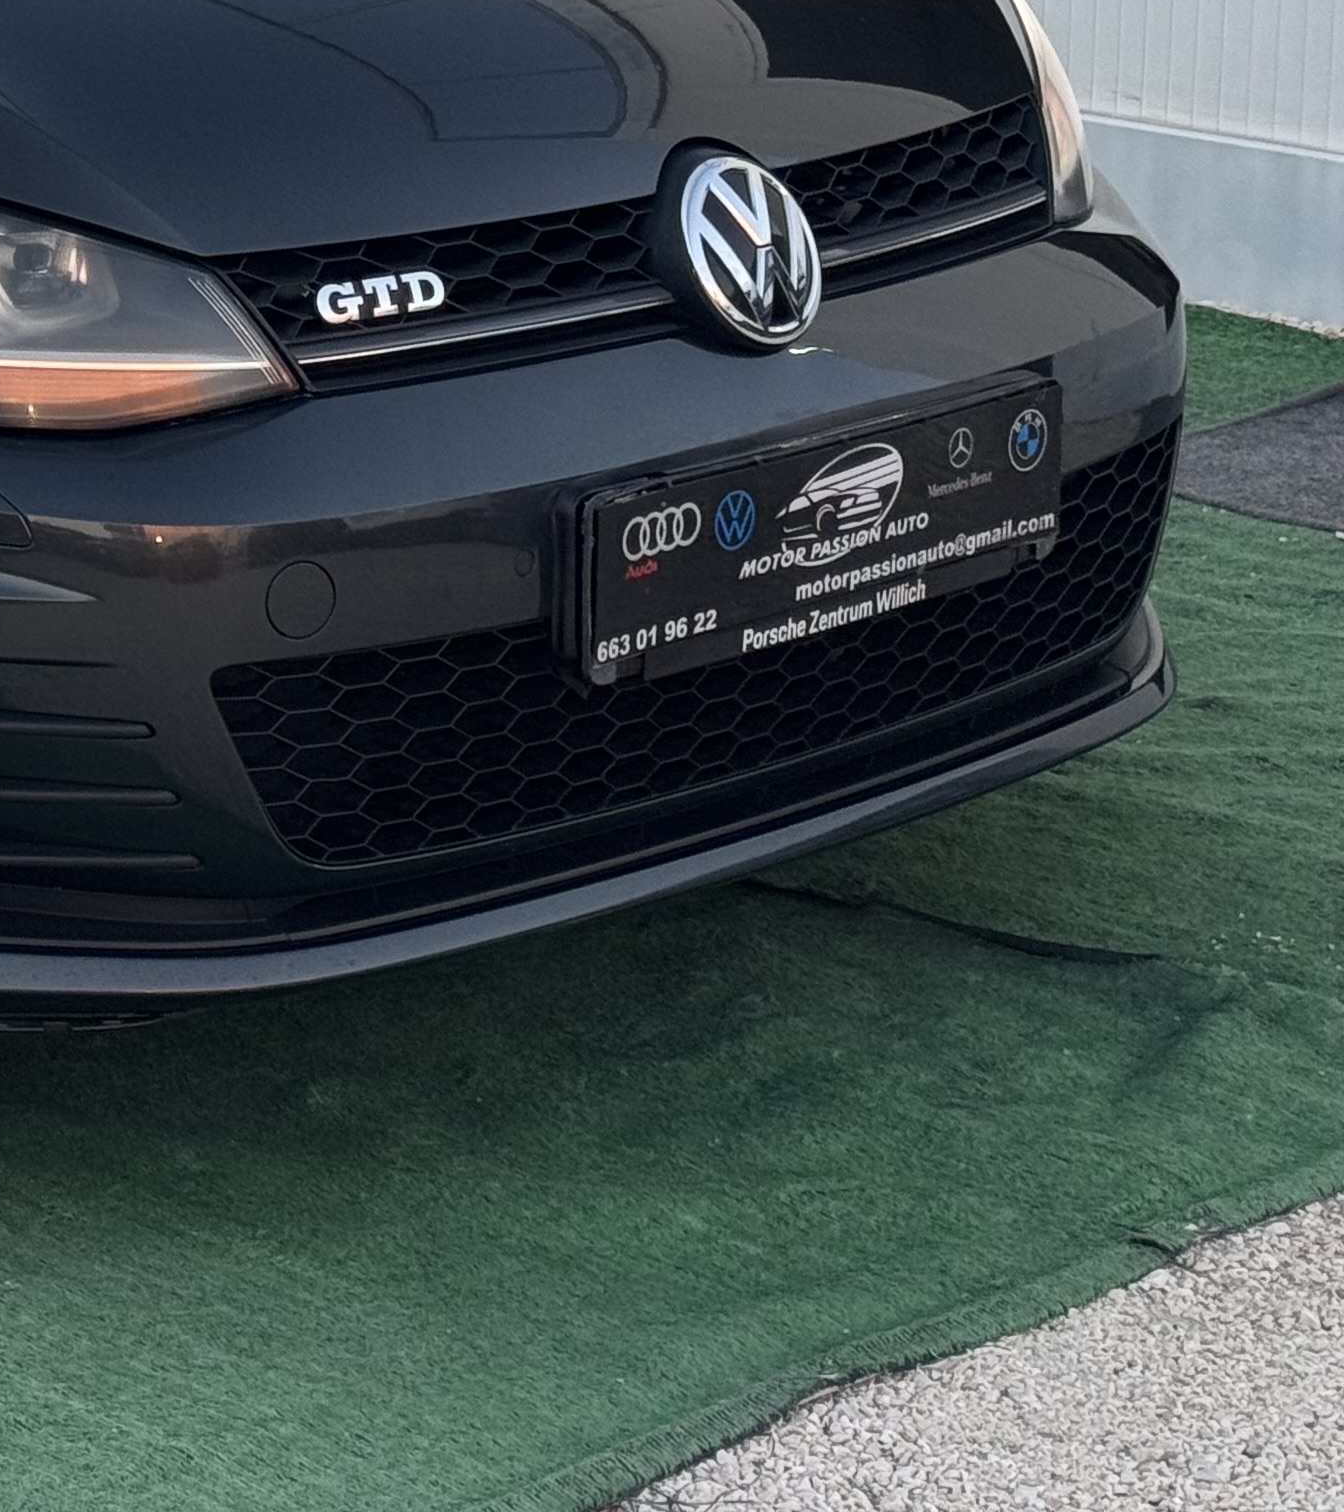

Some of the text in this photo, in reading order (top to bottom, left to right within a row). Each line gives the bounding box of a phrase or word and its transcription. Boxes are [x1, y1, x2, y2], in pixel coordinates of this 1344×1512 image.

[316, 270, 446, 325] GTD
[624, 559, 660, 581] Audi
[737, 511, 930, 581] MOTOR PASSION AUTO
[794, 512, 1056, 602] motorpassionauto@gmail.com
[597, 608, 718, 663] 663 01 96 22
[741, 578, 927, 653] Porsche Zentrum Willich
